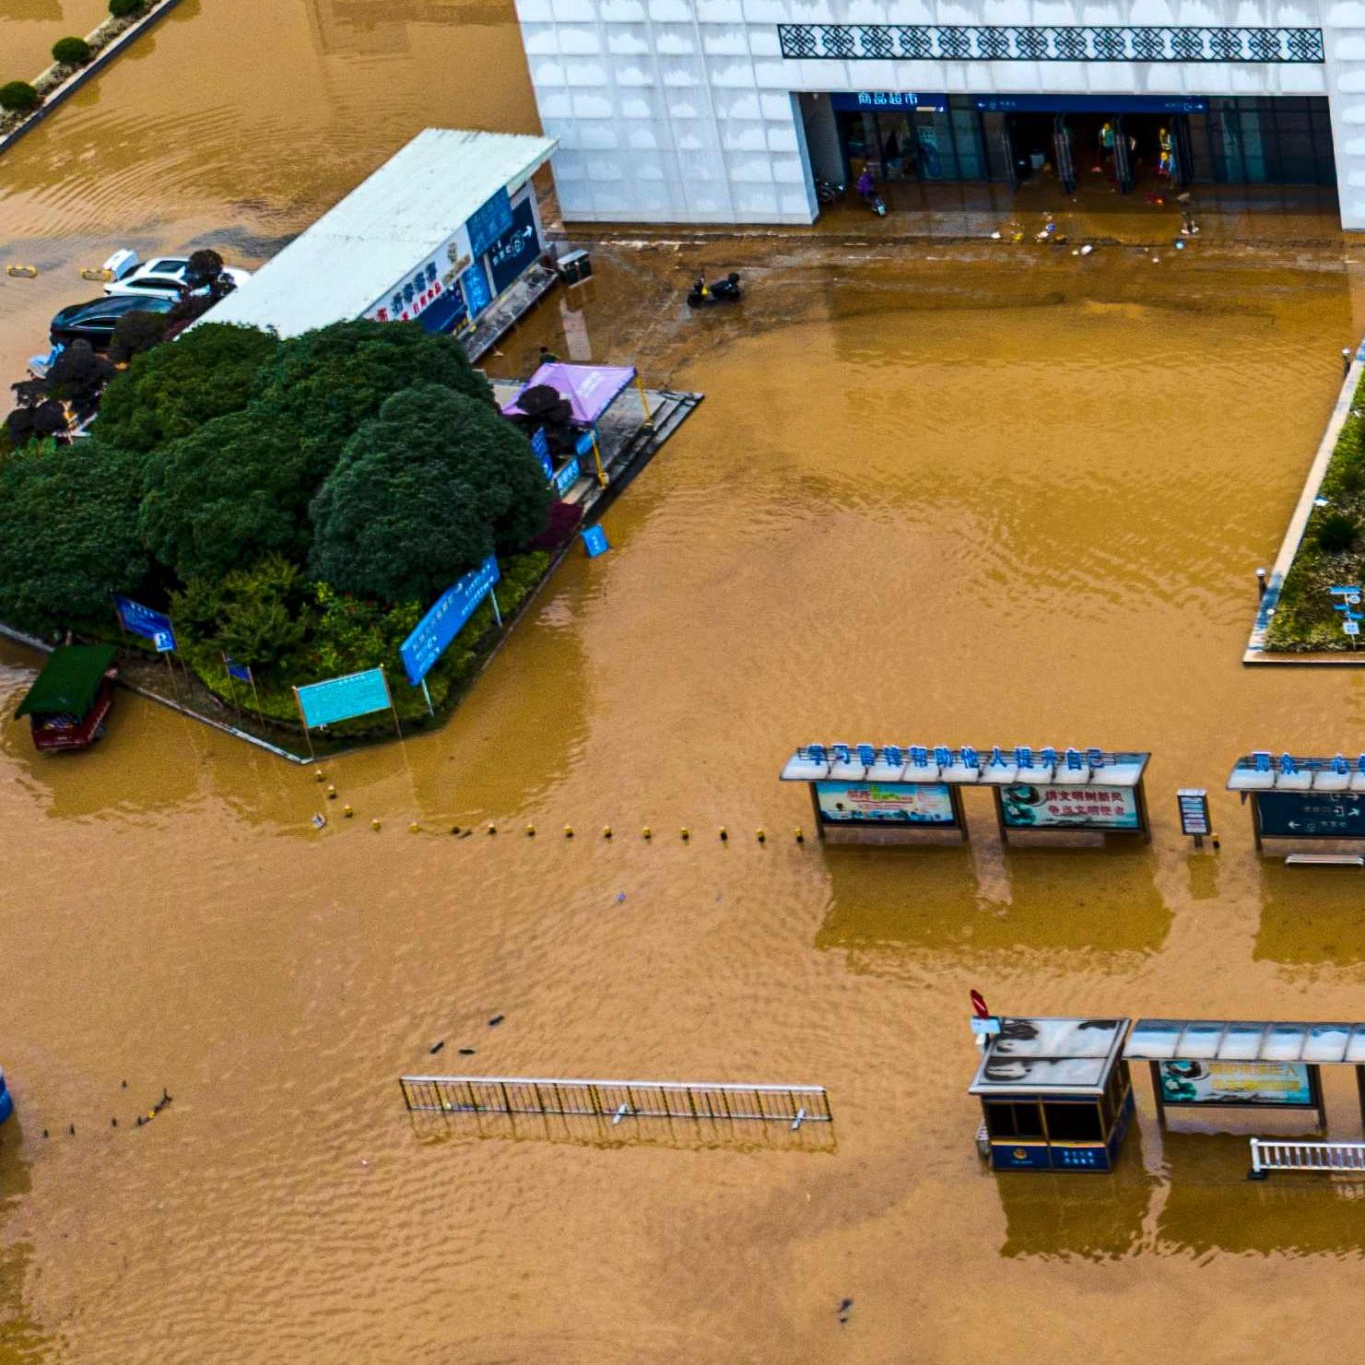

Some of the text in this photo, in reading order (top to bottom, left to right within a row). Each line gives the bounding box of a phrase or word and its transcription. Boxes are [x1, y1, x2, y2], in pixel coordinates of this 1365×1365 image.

[858, 91, 918, 105] 商品超市
[808, 744, 1105, 770] 学习雷锋帮助他人提升自己
